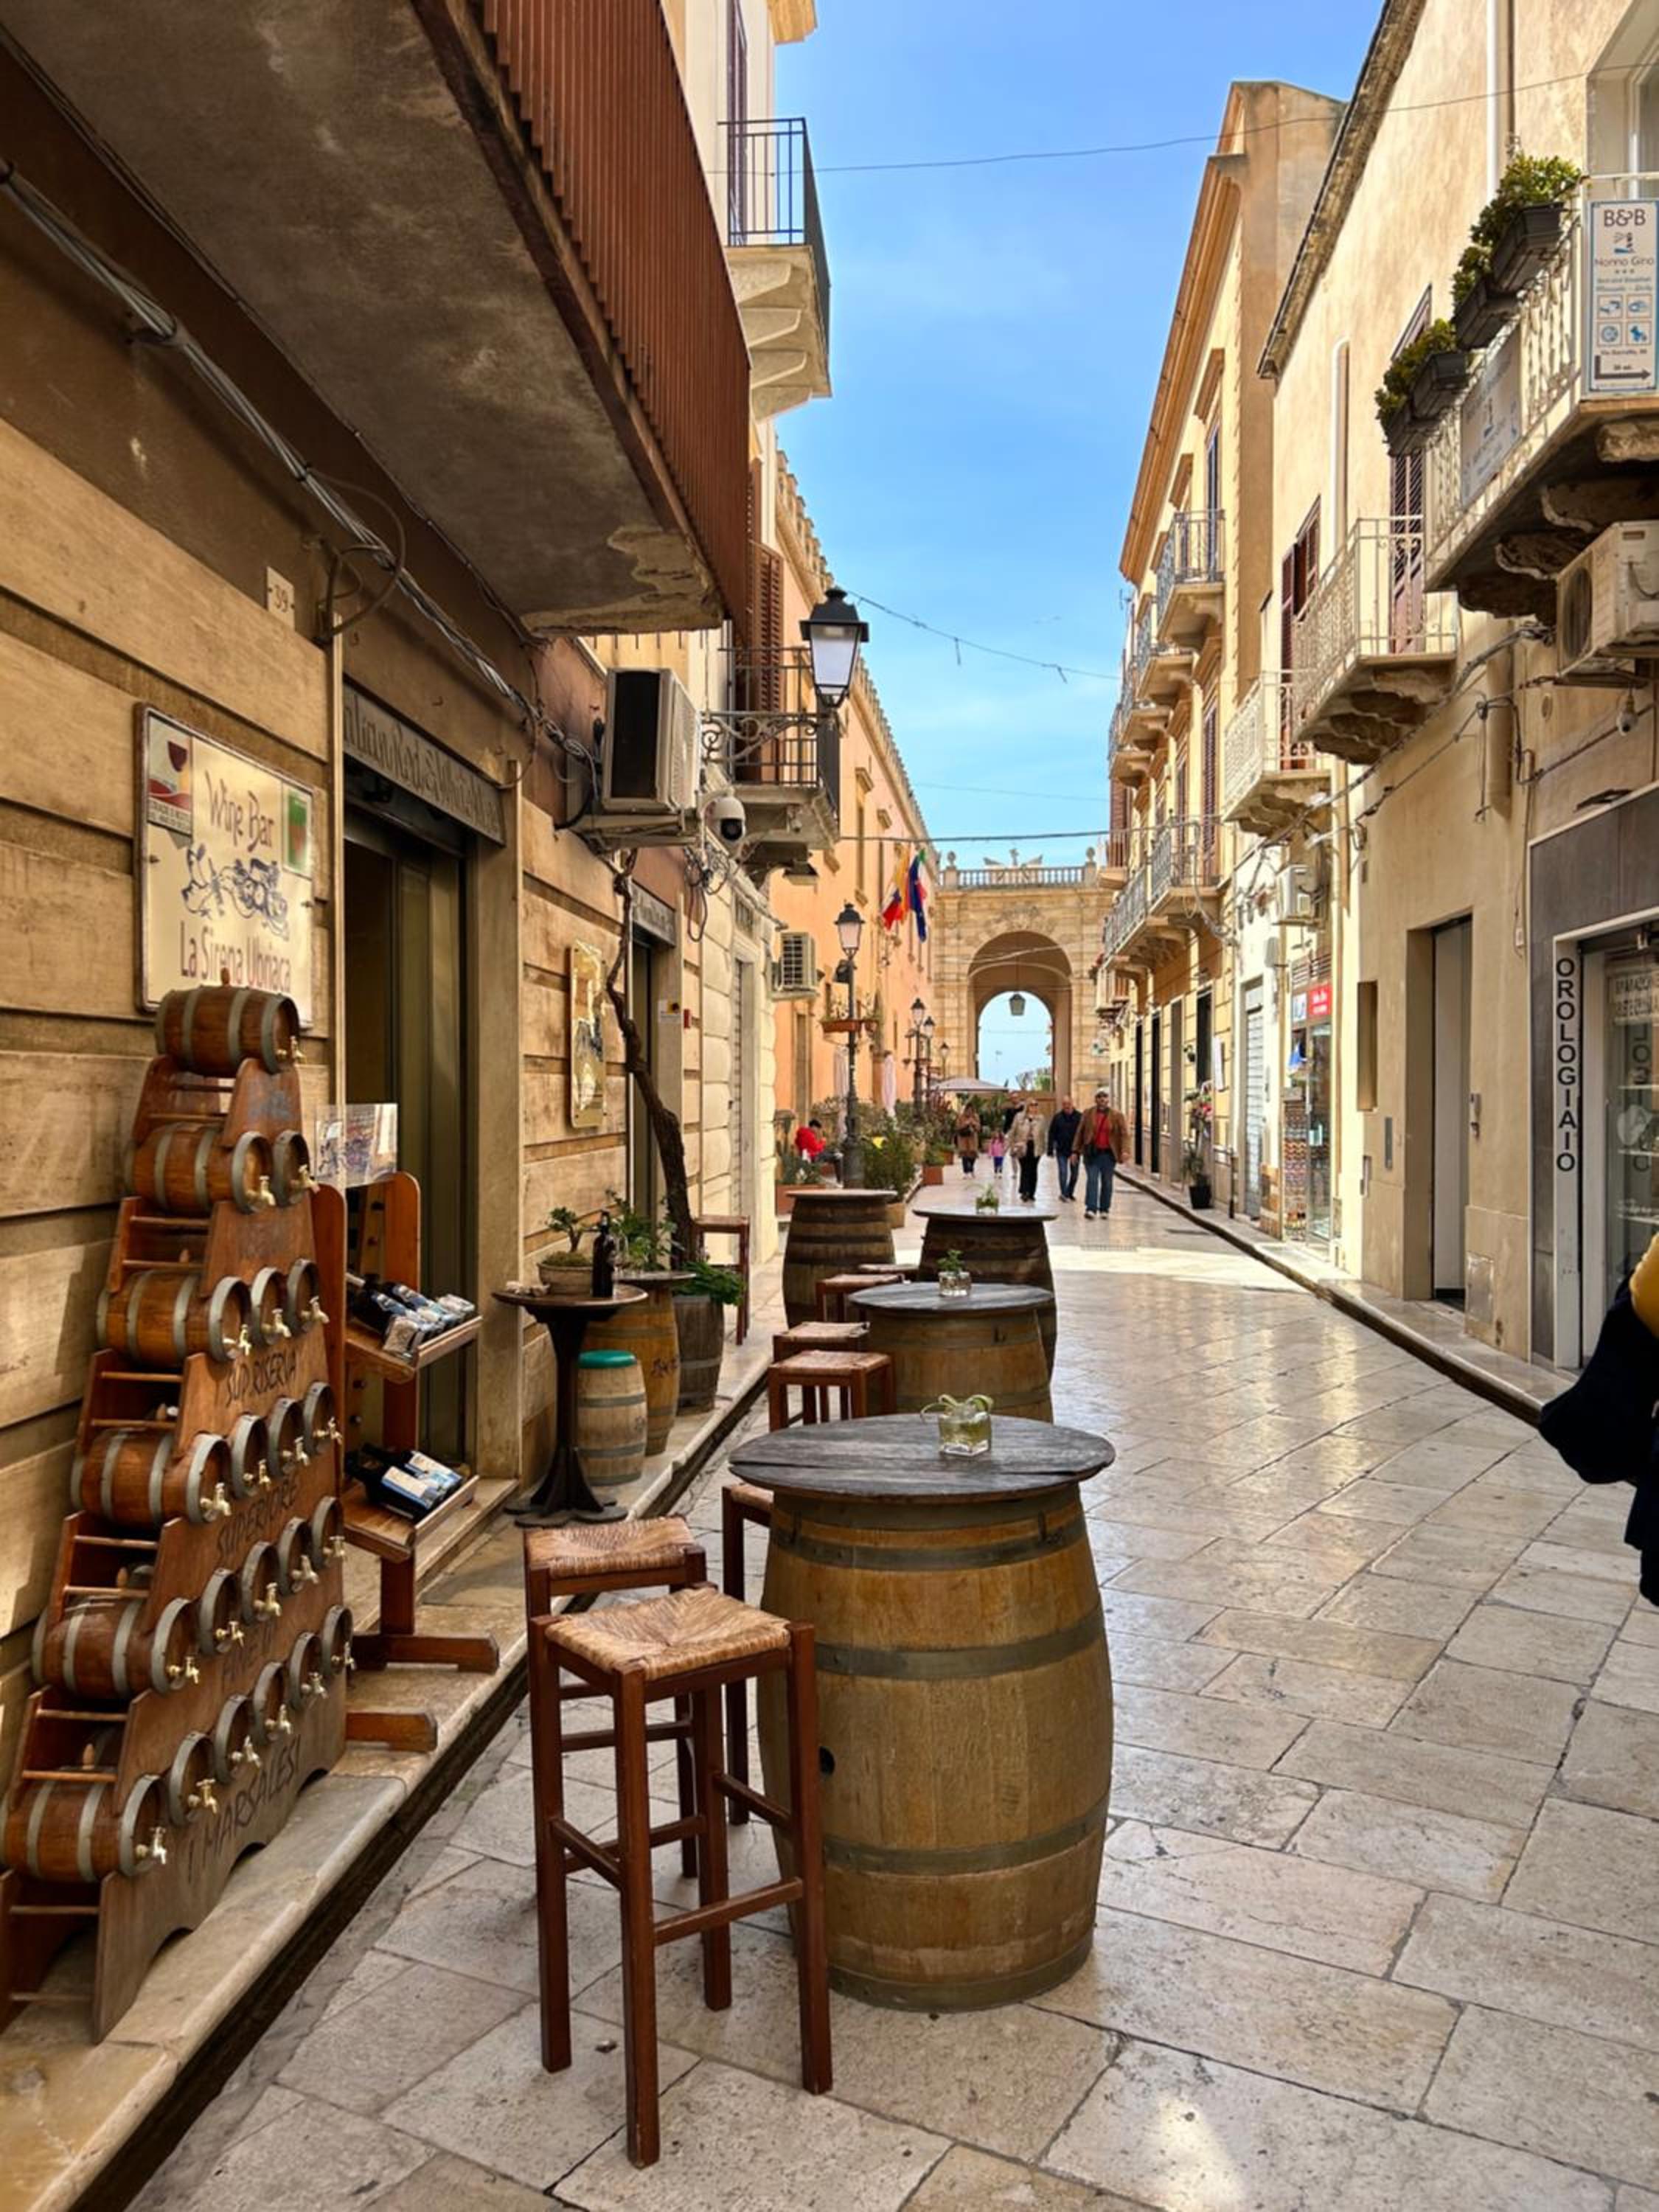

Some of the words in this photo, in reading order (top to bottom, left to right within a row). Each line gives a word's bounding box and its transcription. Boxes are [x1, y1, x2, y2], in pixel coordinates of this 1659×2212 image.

[1604, 208, 1646, 227] B&B
[205, 769, 243, 847] Wine
[248, 790, 274, 853] Bar
[180, 920, 198, 978] La
[201, 926, 243, 984] Sirena
[1557, 957, 1576, 1172] OROLOGIAIO
